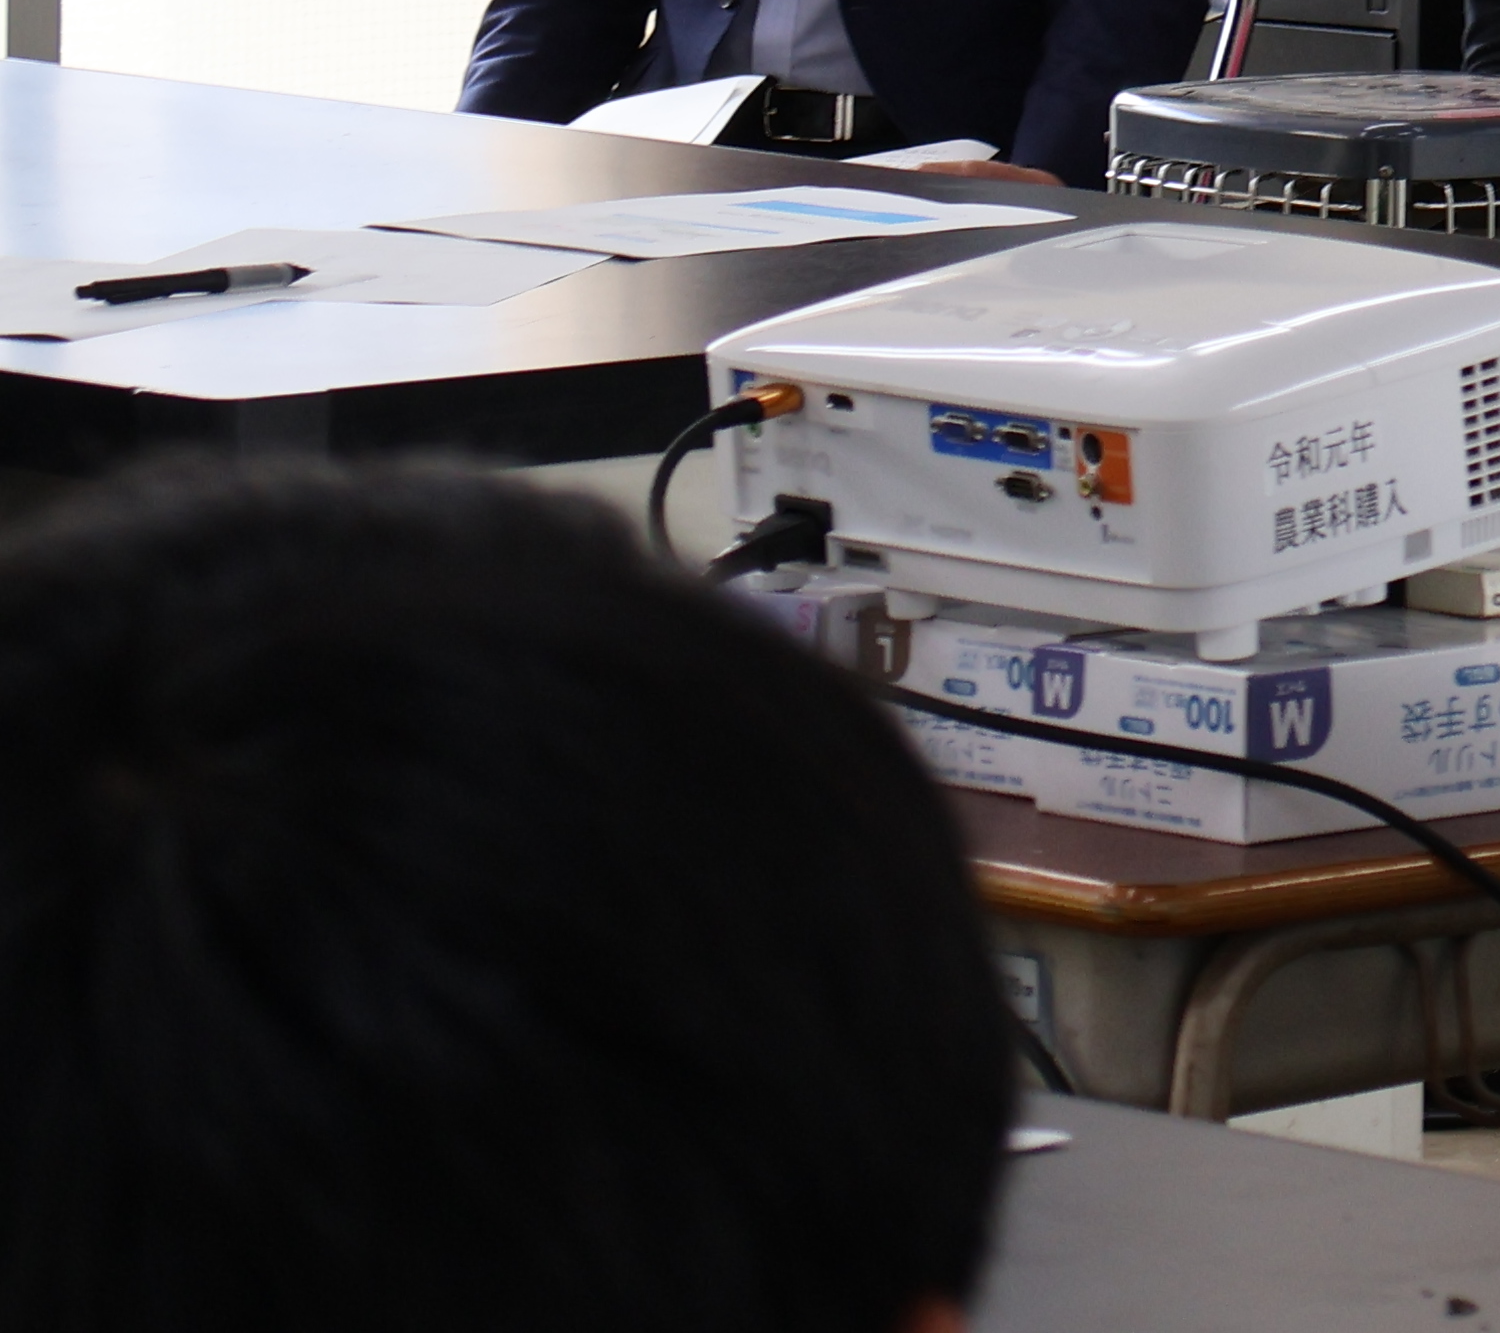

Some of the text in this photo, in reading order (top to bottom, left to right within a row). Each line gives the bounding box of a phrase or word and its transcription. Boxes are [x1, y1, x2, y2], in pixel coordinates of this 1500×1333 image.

[1267, 420, 1375, 485] 令和元年
[1274, 478, 1408, 554] 農業科購入
[1042, 672, 1073, 710] M
[1269, 696, 1315, 749] M
